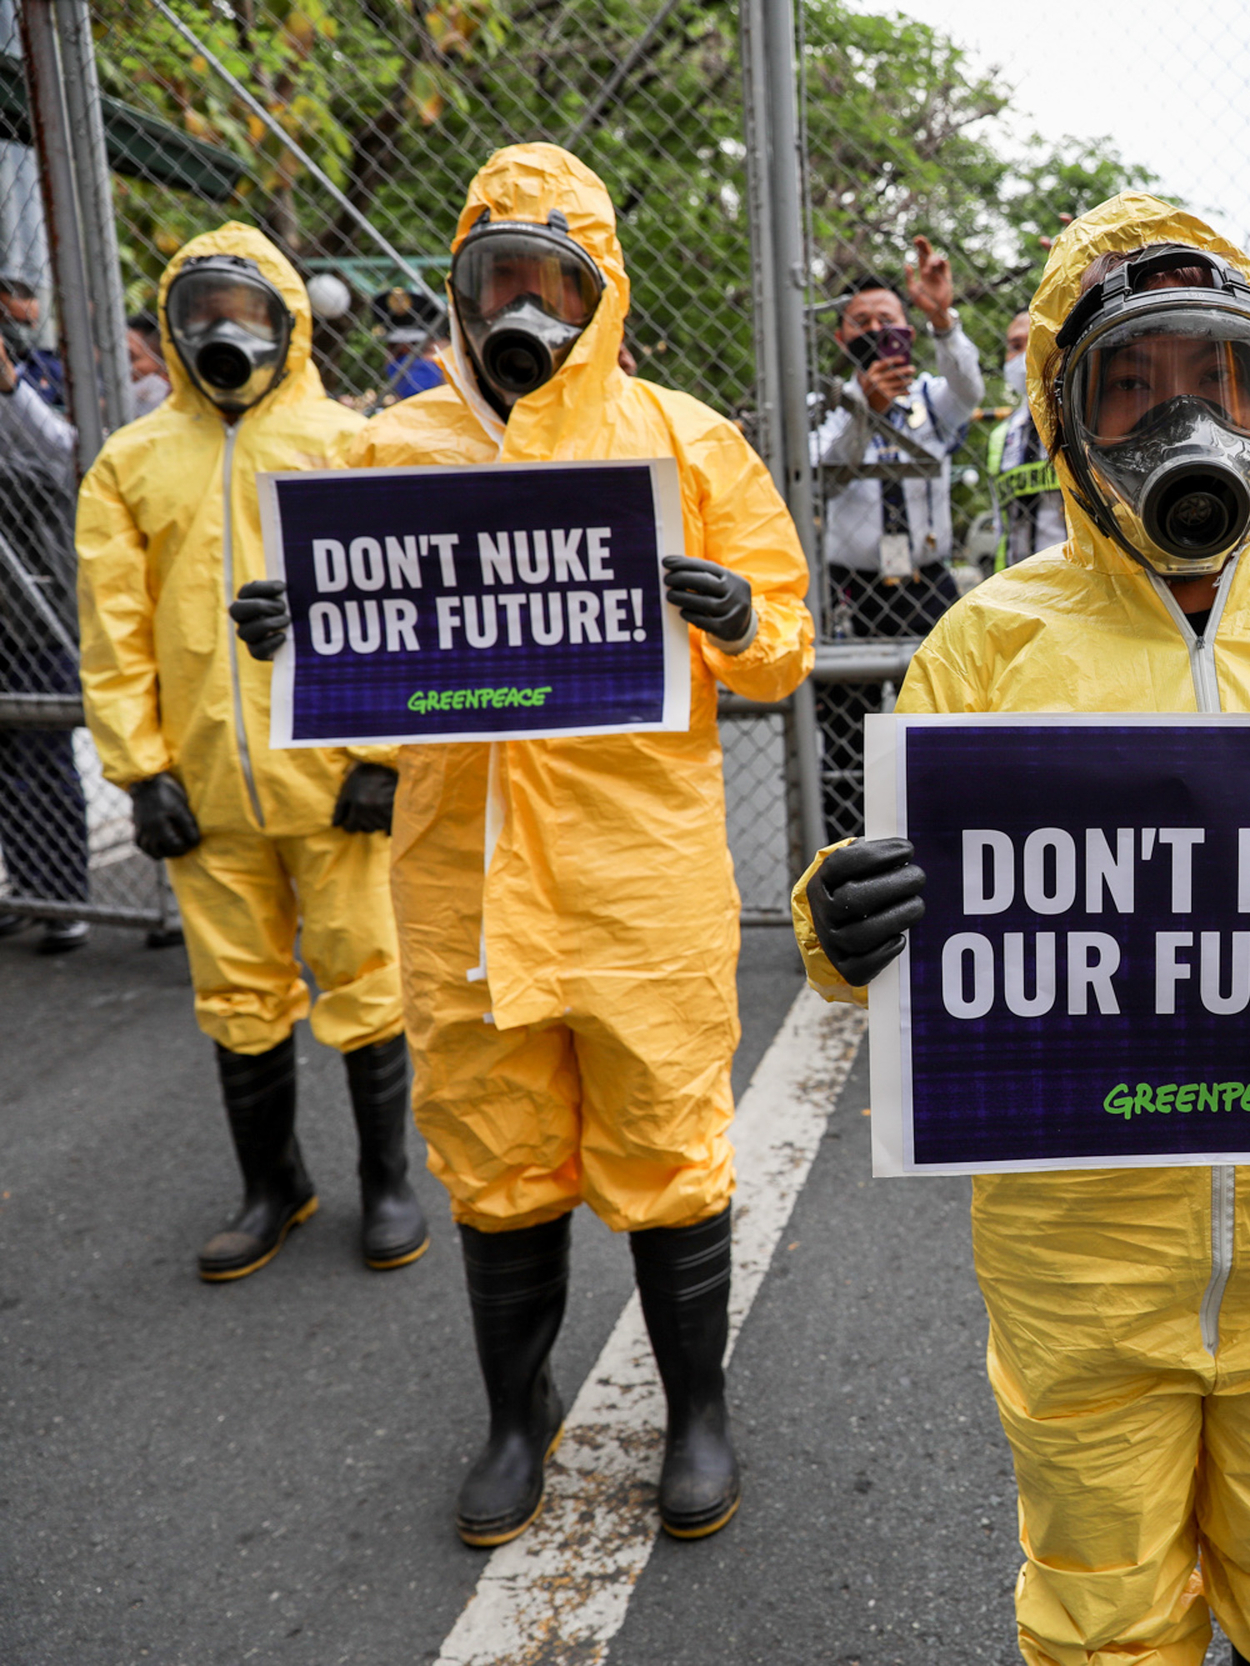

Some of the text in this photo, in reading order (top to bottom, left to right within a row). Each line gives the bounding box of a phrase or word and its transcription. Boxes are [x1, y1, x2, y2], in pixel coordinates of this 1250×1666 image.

[313, 528, 614, 593] DON'T NUKE
[310, 589, 645, 655] OUR FUTURE!
[408, 687, 552, 713] GREENPEACE
[963, 828, 1204, 915] DON'T
[942, 932, 1121, 1019] OUR
